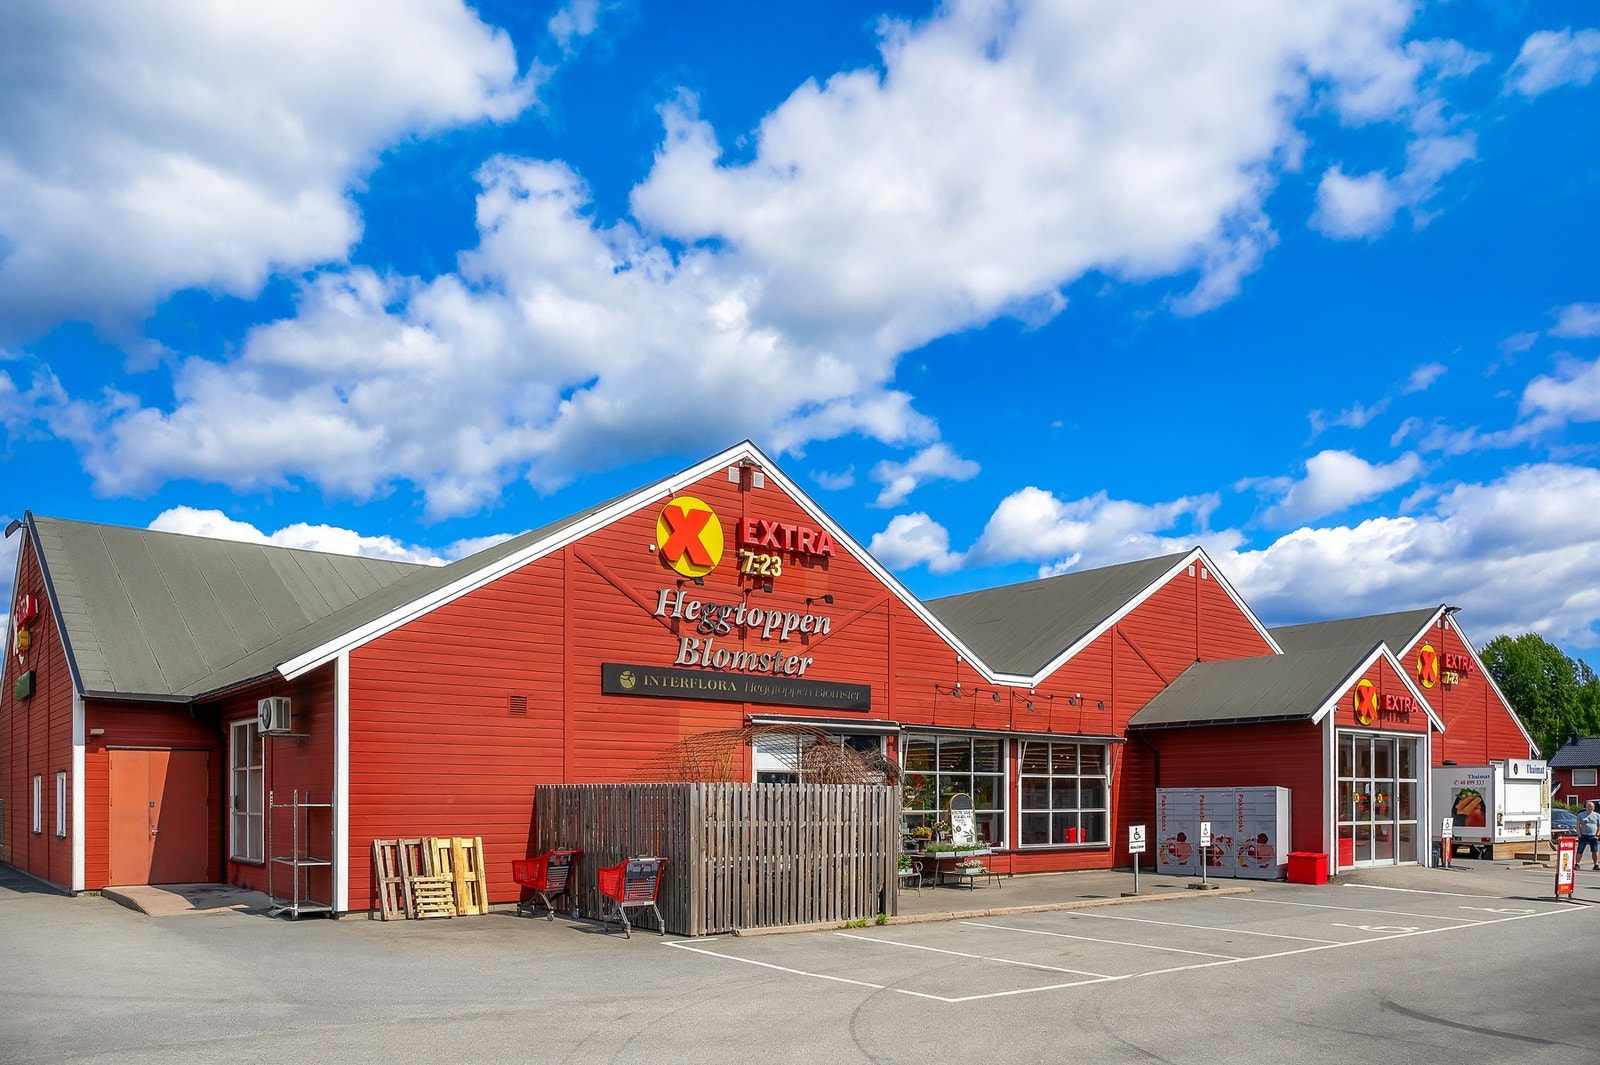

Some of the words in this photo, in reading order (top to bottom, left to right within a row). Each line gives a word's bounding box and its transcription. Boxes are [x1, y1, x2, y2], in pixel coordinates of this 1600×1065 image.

[661, 505, 714, 567] X
[740, 517, 836, 558] EXTRA
[741, 549, 783, 577] 7-23
[653, 587, 831, 641] Heggtoppen
[674, 636, 814, 677] Blomster
[1421, 651, 1437, 682] X
[1445, 653, 1475, 672] EXTRA
[643, 674, 738, 693] INTERFLORA
[744, 681, 812, 698] Heggtoppen
[814, 687, 861, 701] Blomster
[1357, 685, 1379, 719] X
[1386, 694, 1419, 713] EXTRA
